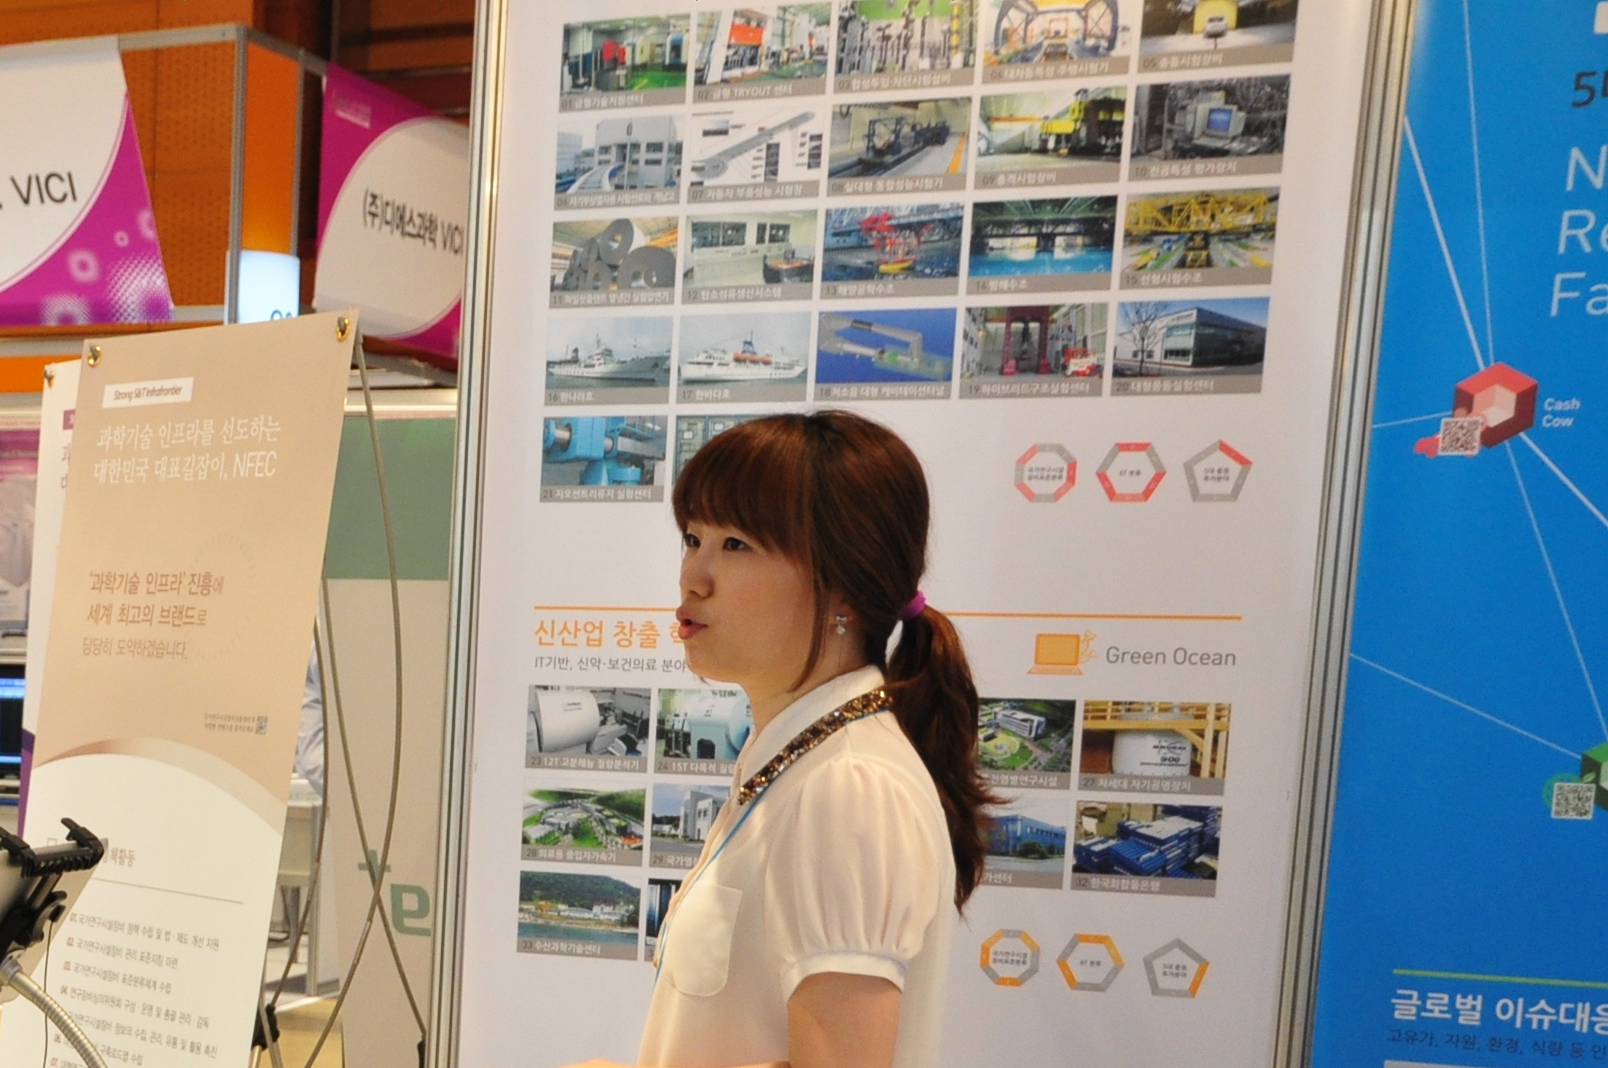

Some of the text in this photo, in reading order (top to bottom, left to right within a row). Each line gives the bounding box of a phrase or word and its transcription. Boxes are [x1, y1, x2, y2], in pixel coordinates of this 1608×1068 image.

[733, 85, 770, 98] TRYOUT
[10, 171, 77, 206] VICI
[362, 187, 438, 248] (주)디에스과학
[113, 389, 134, 402] Strong
[681, 389, 730, 400] 17 한바다호
[1544, 397, 1581, 412] Cash
[1542, 414, 1574, 428] Cow
[97, 414, 281, 452] 과학기술 인프라를 선도하는
[94, 457, 150, 485] 대한민국
[232, 451, 278, 478] NFEC
[188, 571, 225, 596] 진흥에
[87, 602, 208, 627] 세계 최고의 브랜드로
[534, 619, 661, 649] 신산업 창출
[83, 637, 188, 660] 당당히 도약하겠습니다.
[1106, 645, 1236, 667] Green Ocean
[534, 656, 573, 671] IT기반,
[531, 757, 541, 766] 23
[543, 757, 558, 767] 12T
[658, 762, 668, 771] 24
[672, 762, 687, 772] 15T
[1097, 776, 1128, 789] 차세대
[1076, 877, 1088, 887] 32
[534, 940, 601, 955] 수산과학기술센터
[1391, 988, 1483, 1026] 글로벌
